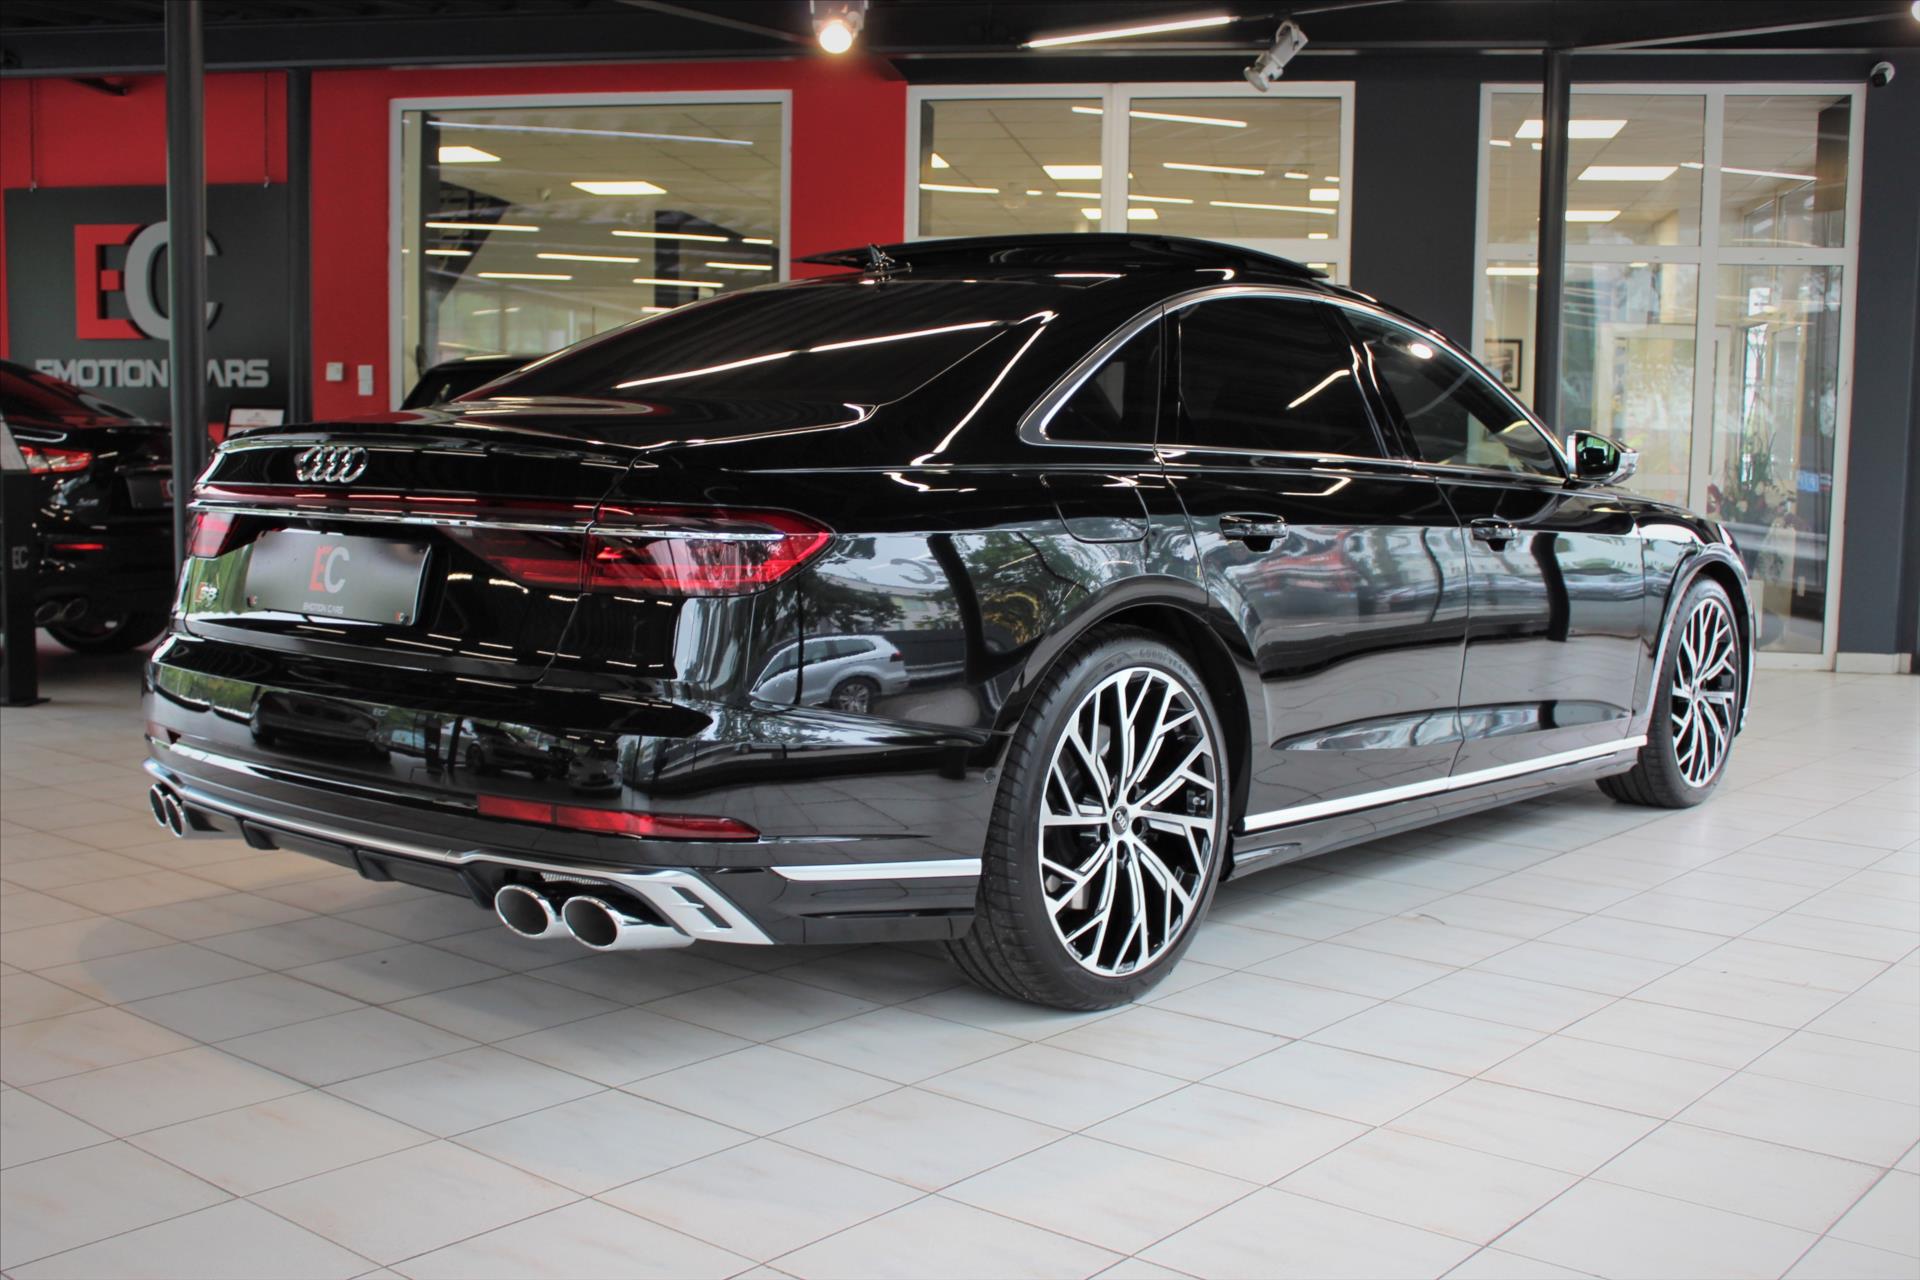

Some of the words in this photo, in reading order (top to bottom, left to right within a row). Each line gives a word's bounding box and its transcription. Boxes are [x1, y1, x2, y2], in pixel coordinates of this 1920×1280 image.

[206, 359, 269, 388] ARS
[12, 546, 28, 569] EC
[308, 544, 350, 594] EC
